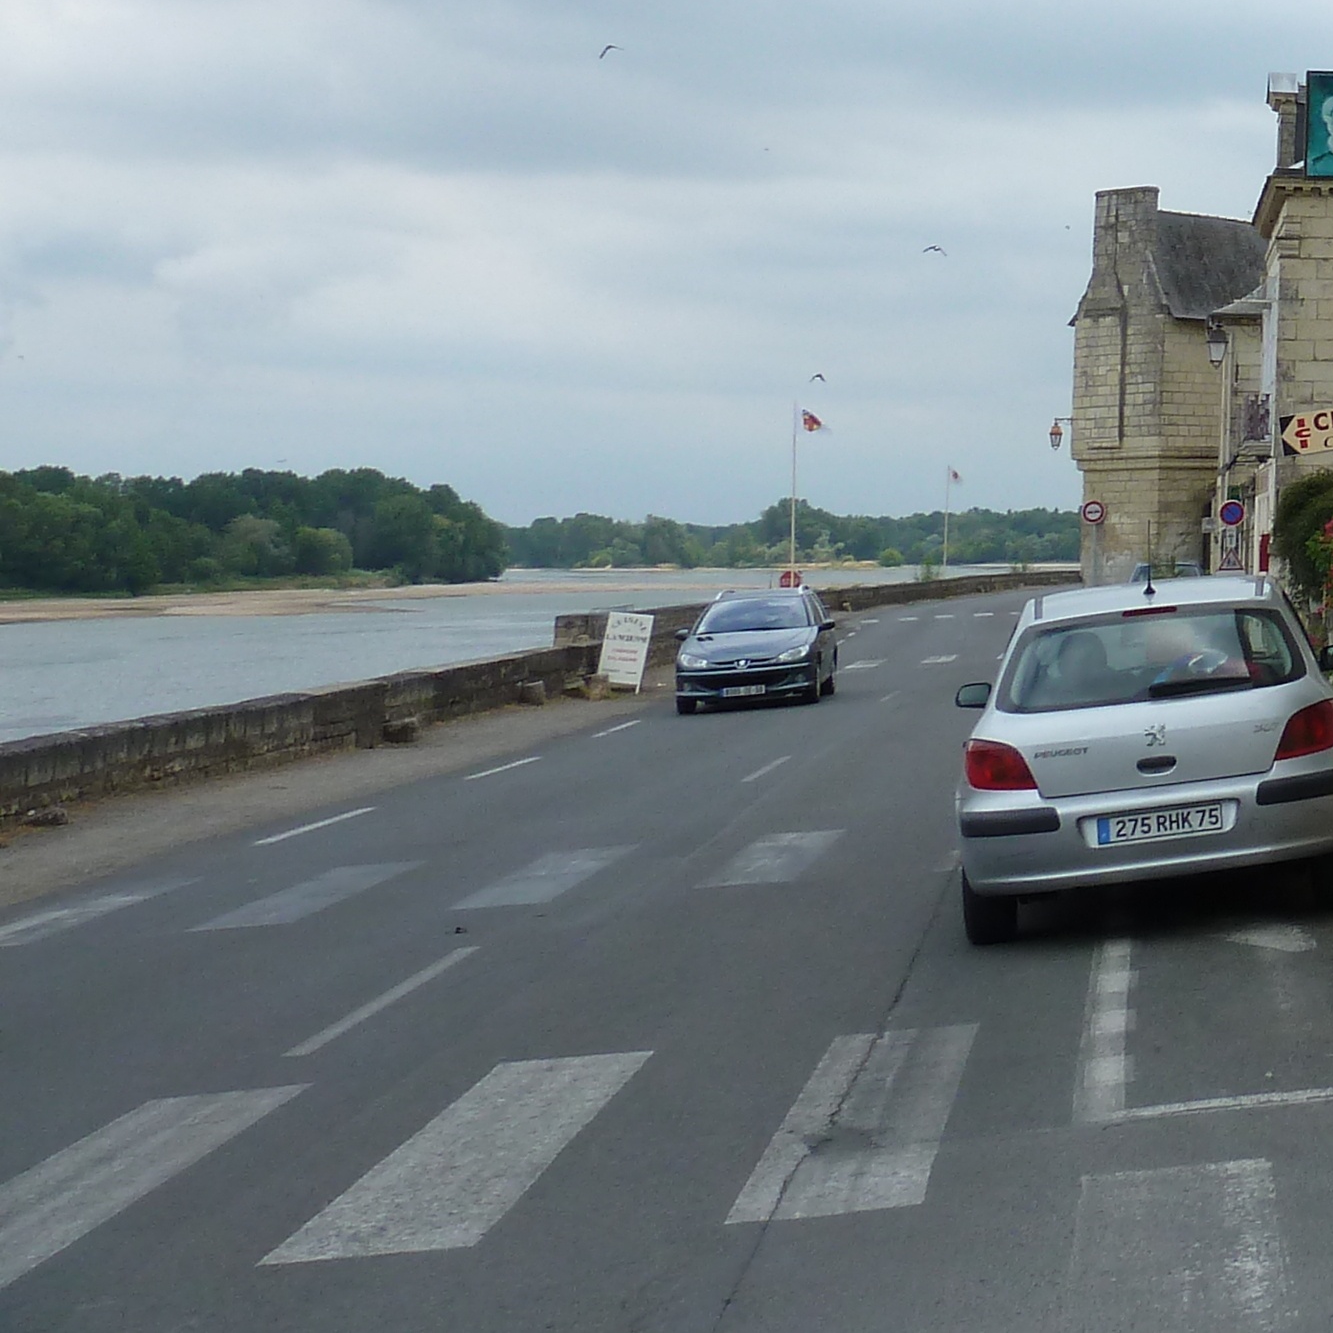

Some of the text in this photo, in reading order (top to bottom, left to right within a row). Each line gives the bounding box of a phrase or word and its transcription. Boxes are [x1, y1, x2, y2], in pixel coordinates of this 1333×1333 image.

[1033, 747, 1089, 759] PEUGEOT
[1115, 807, 1220, 838] 275 RHK 75
